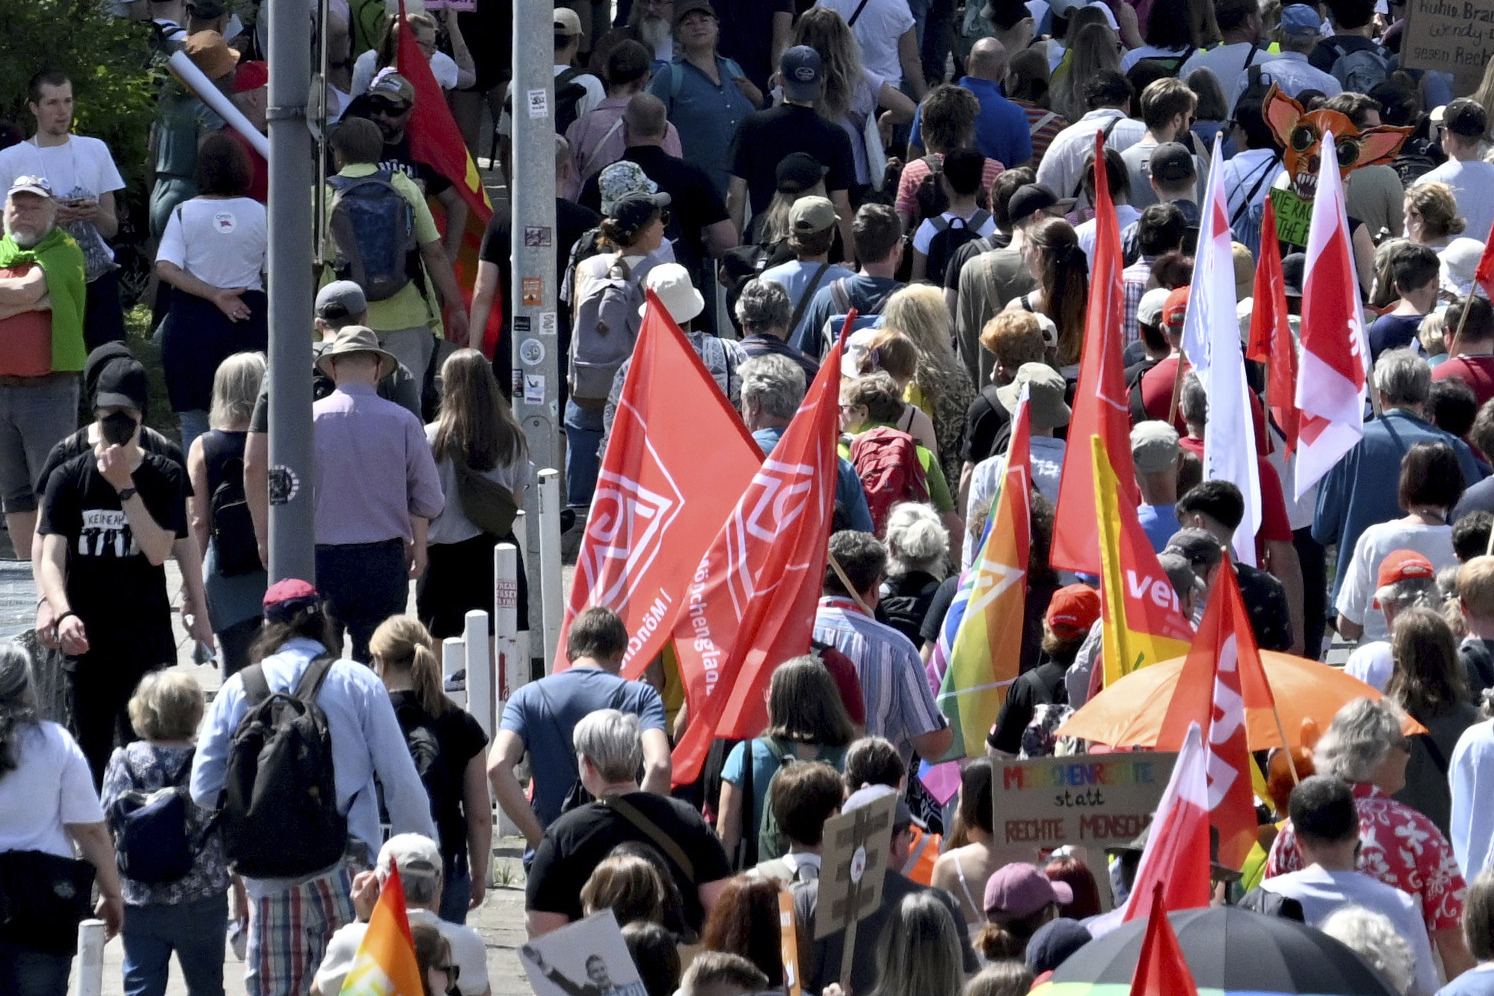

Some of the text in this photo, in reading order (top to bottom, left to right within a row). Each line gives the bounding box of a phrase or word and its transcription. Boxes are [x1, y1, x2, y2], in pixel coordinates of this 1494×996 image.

[1054, 788, 1106, 808] statt
[1004, 813, 1154, 844] RECHTE MENSCH
